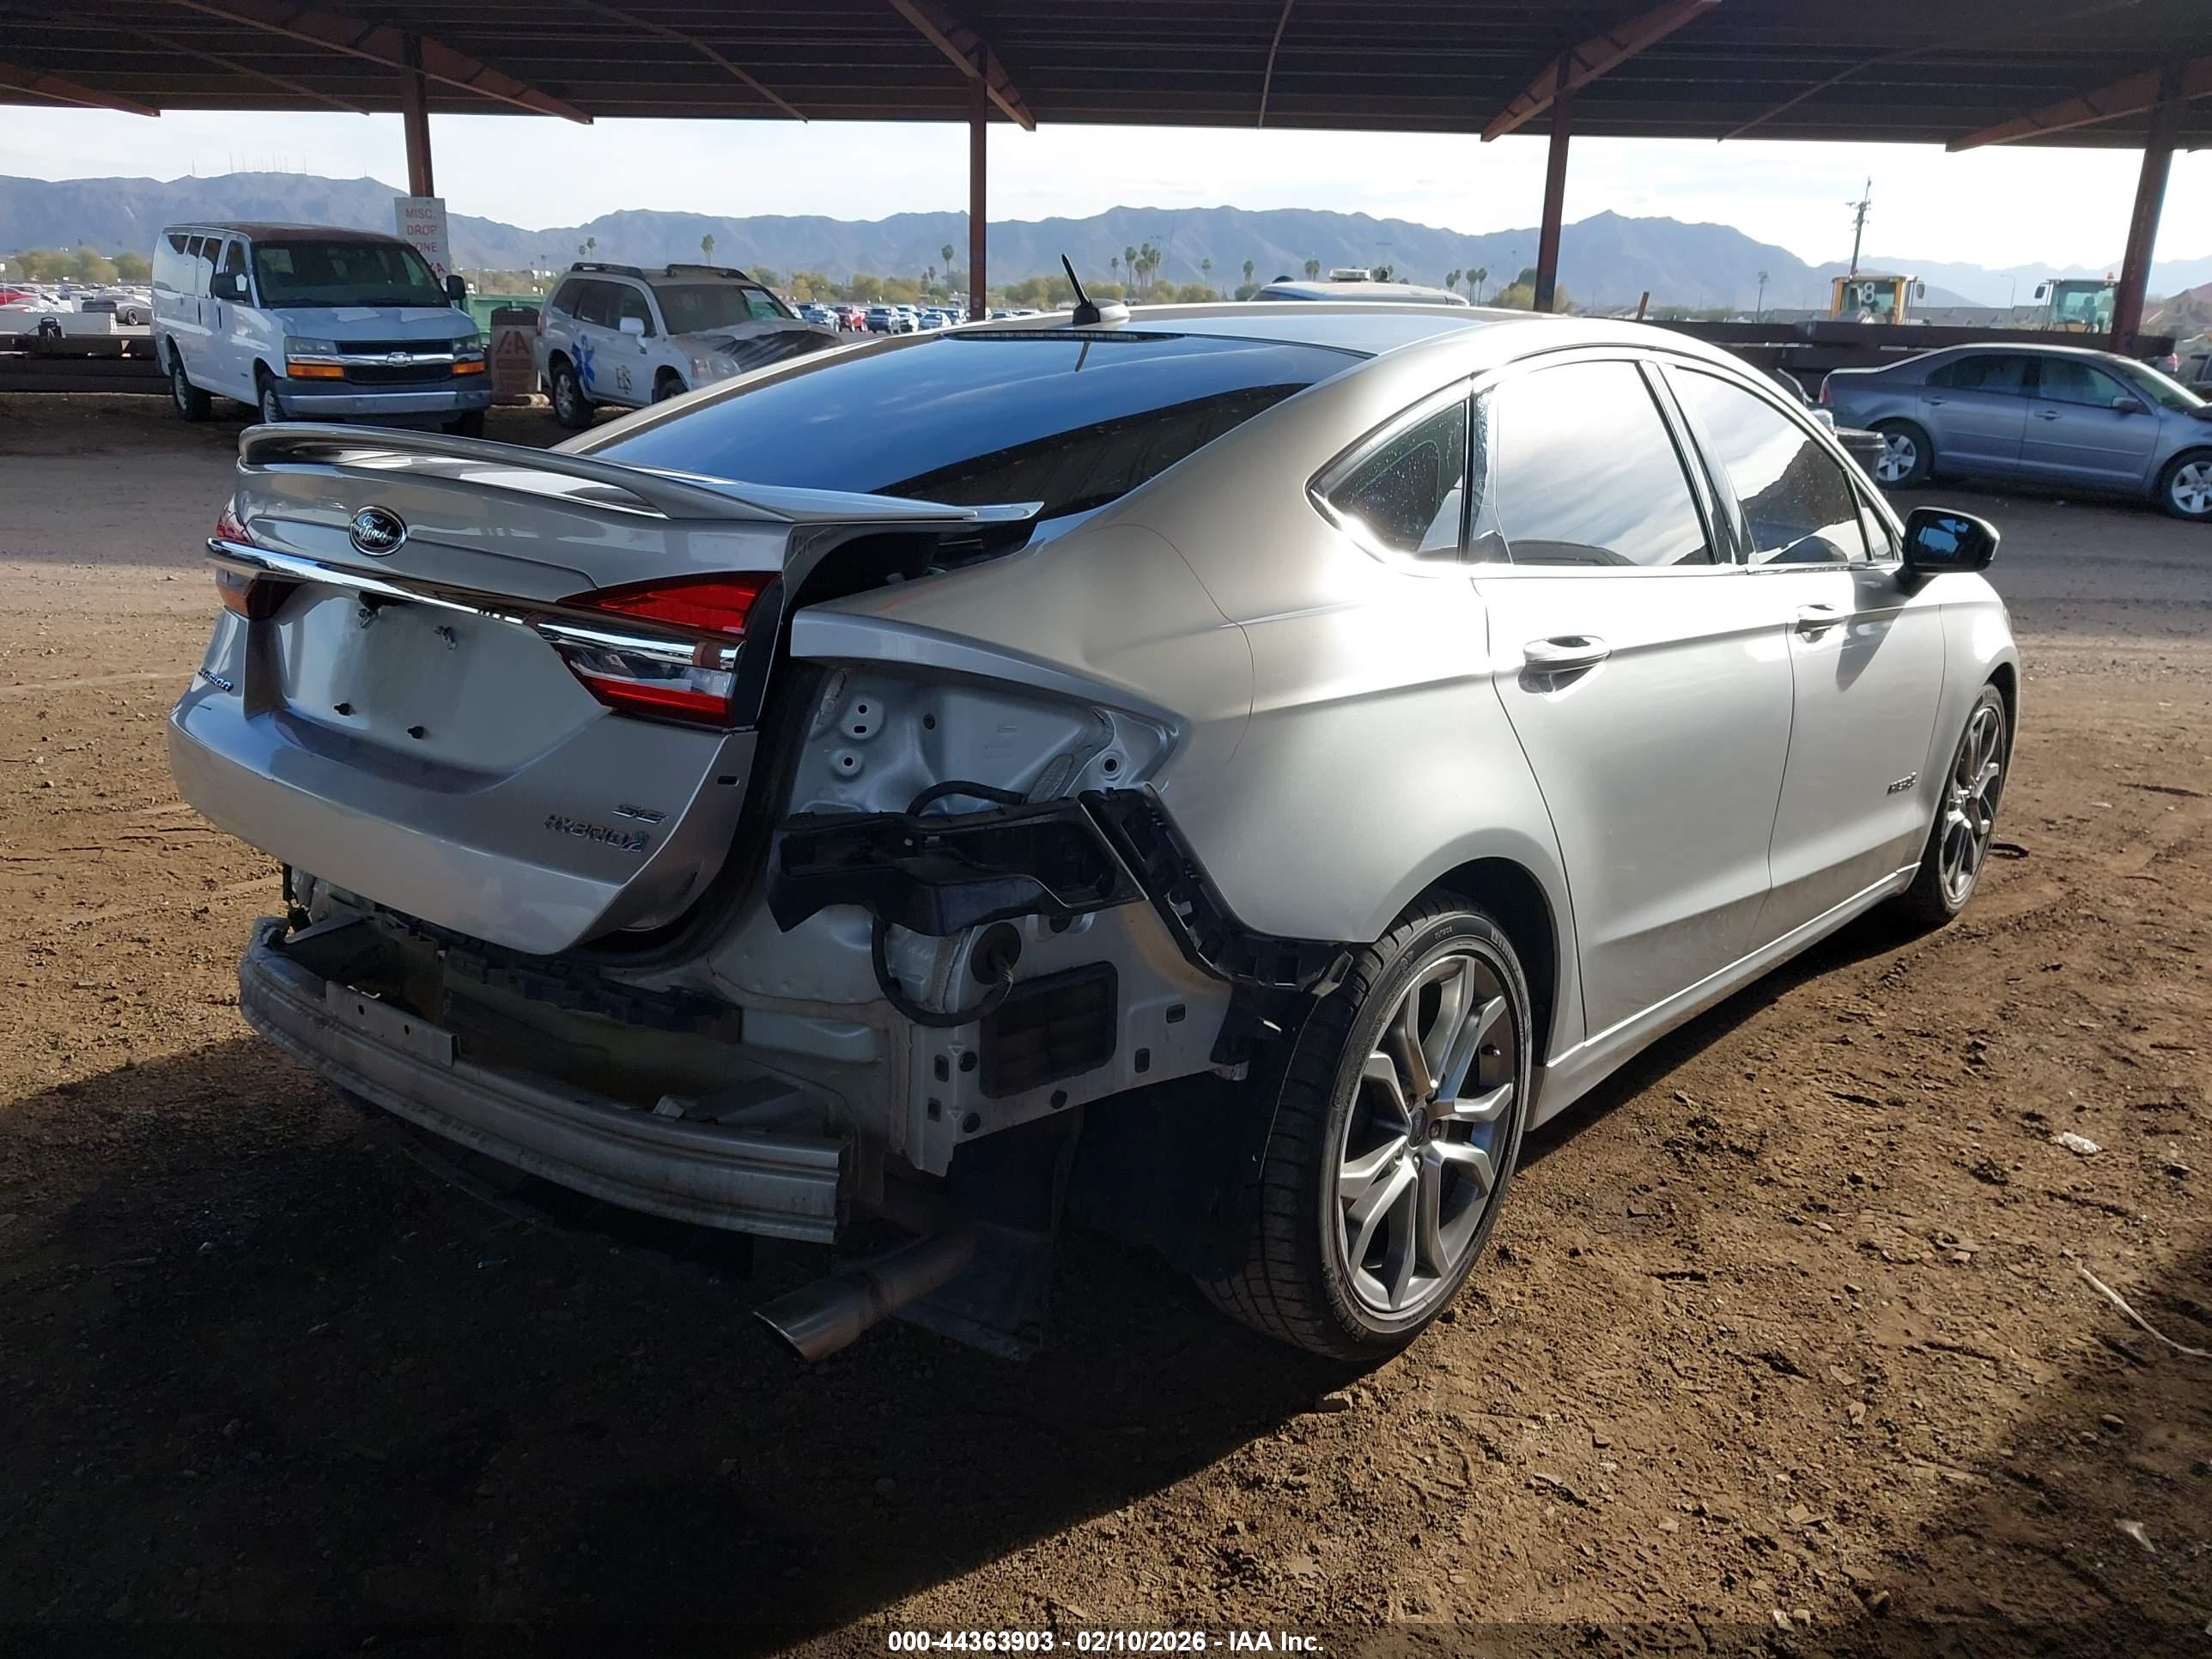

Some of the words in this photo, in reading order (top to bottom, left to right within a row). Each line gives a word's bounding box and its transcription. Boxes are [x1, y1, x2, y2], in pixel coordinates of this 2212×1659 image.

[404, 208, 436, 220] MISC.
[406, 224, 438, 236] DROP
[611, 803, 668, 824] SE
[543, 813, 629, 848] HYBRID
